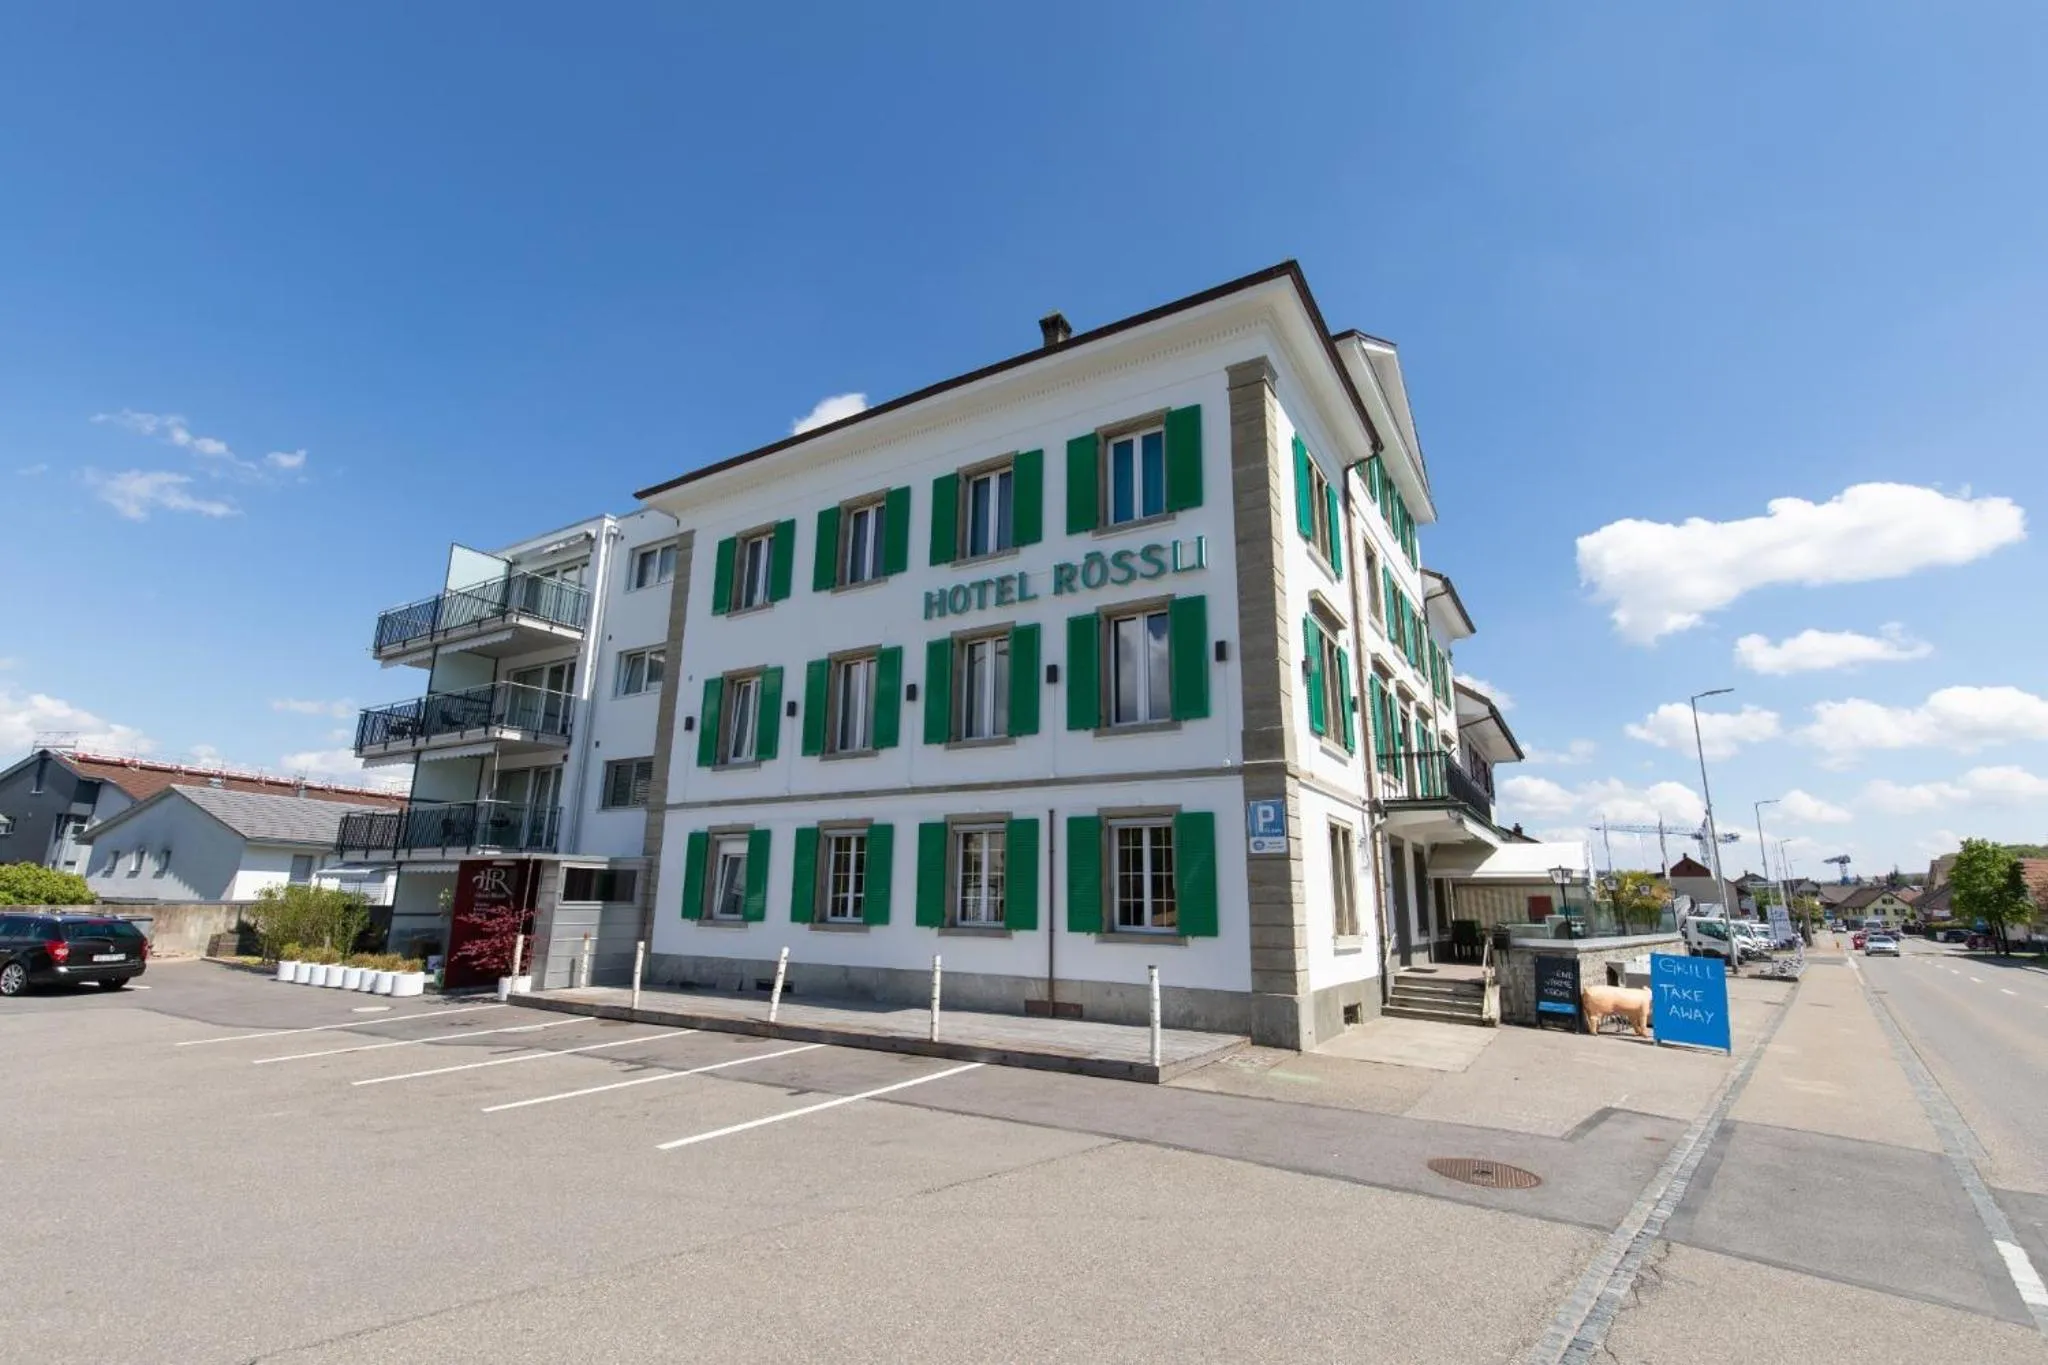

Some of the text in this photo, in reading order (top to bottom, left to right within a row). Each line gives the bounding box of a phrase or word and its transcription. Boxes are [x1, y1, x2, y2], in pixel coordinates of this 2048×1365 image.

[923, 535, 1208, 620] HOTEL RÖSSLI
[1257, 805, 1275, 833] P
[1659, 957, 1717, 980] GRILL
[1658, 983, 1704, 1003] TAKE
[1668, 1004, 1715, 1025] AWAY
